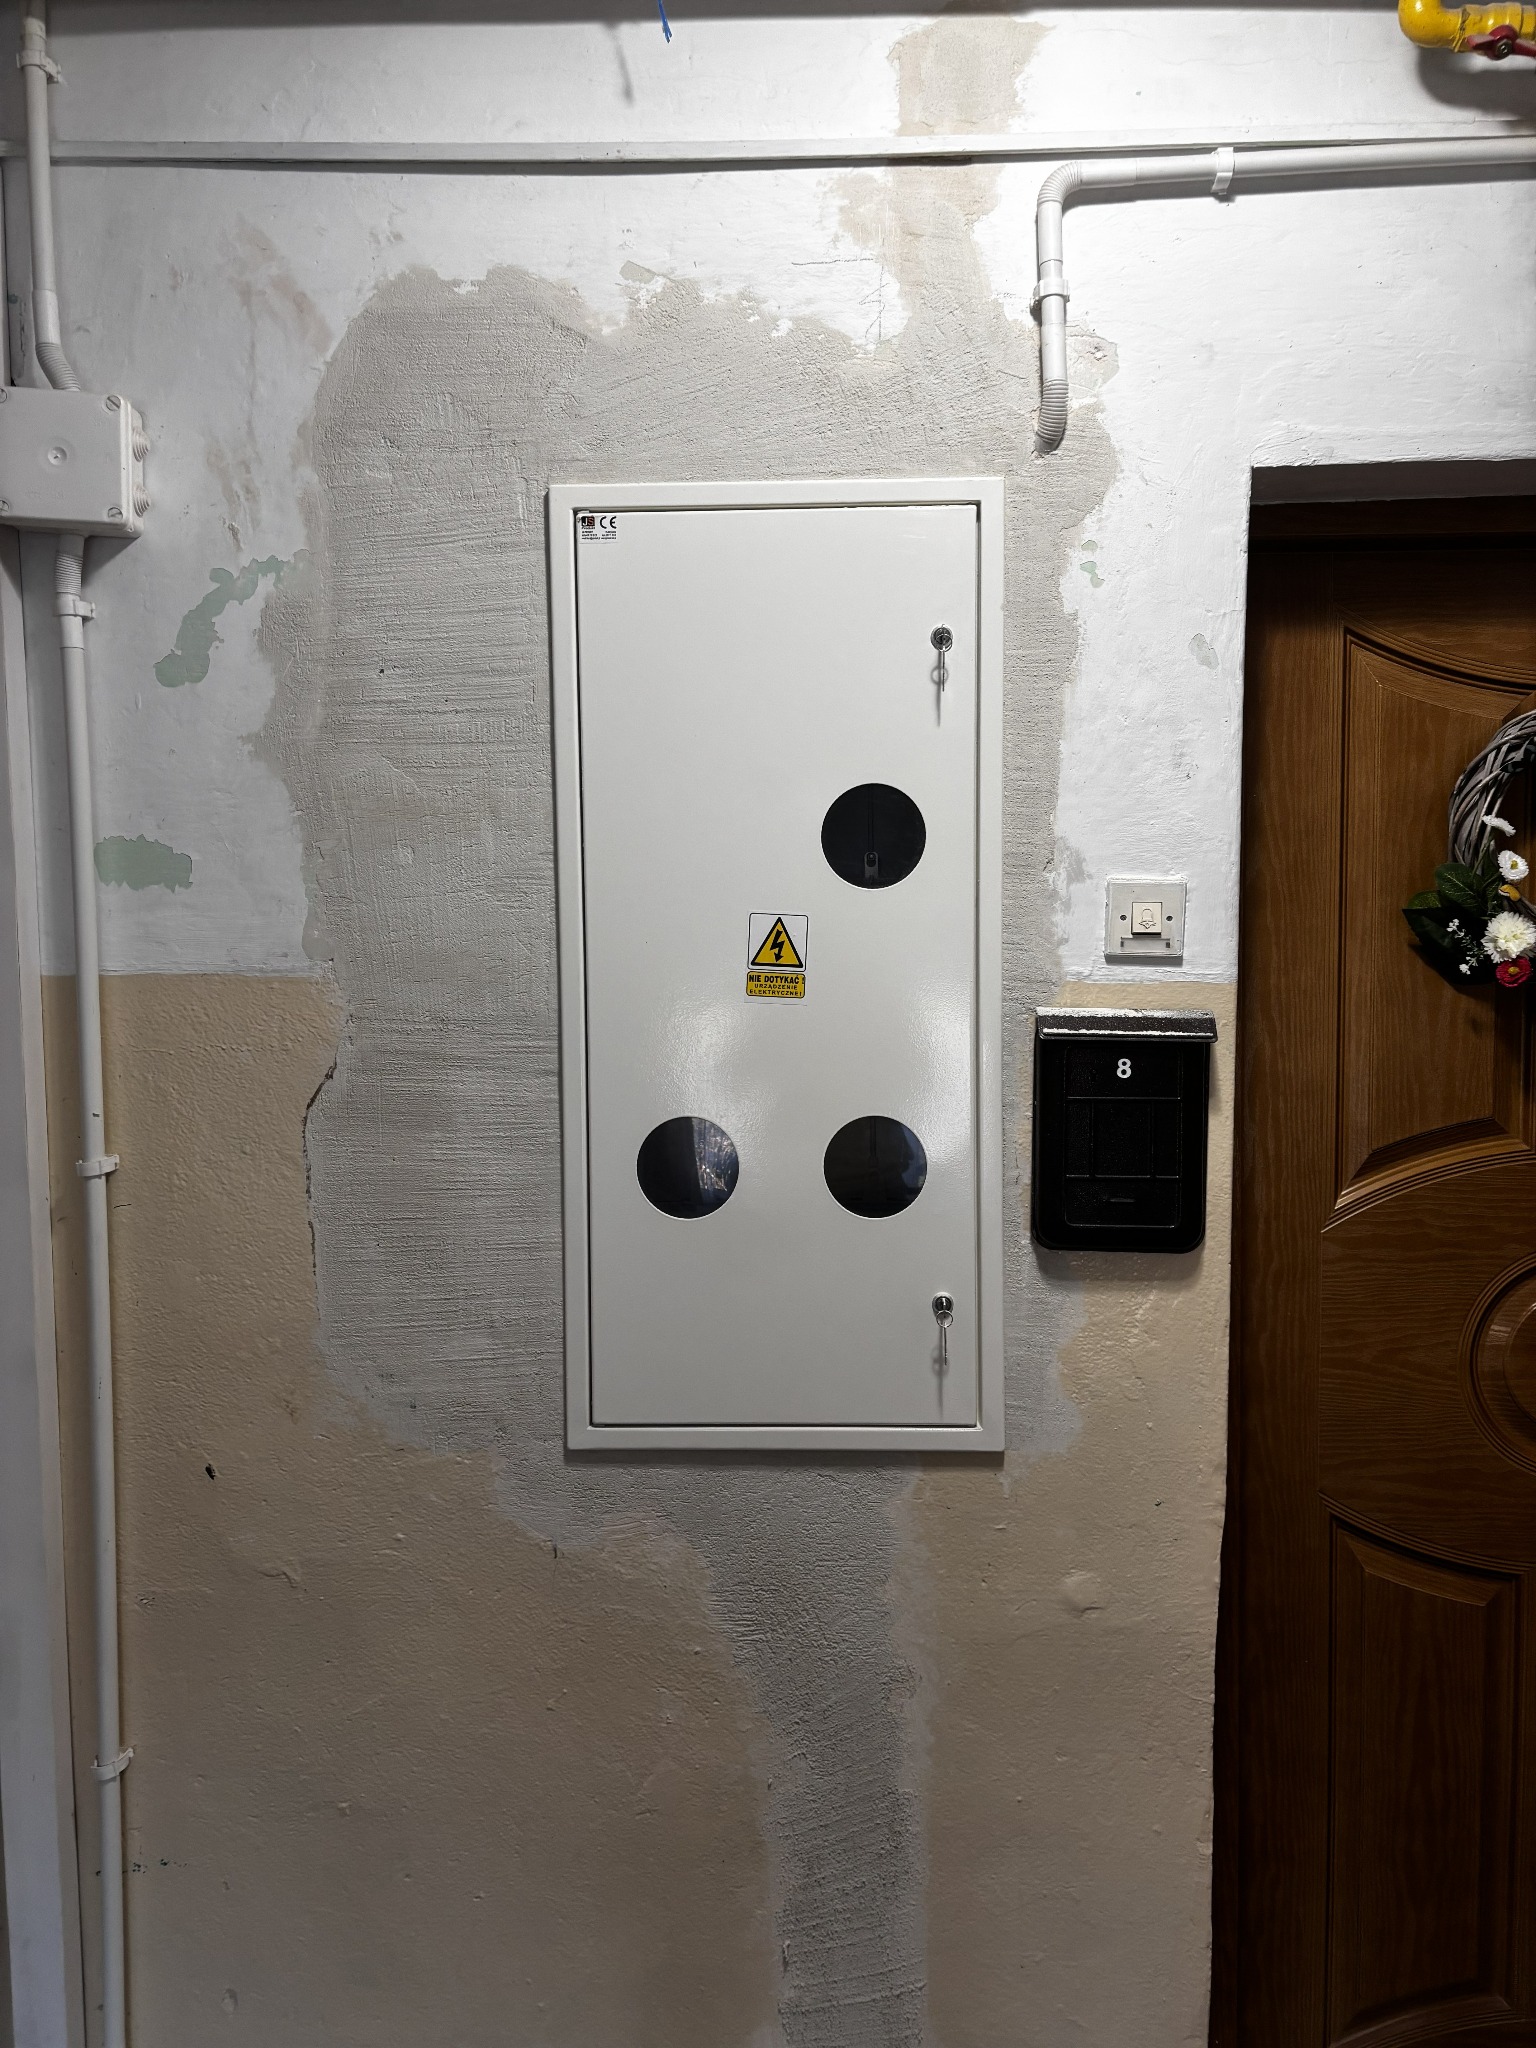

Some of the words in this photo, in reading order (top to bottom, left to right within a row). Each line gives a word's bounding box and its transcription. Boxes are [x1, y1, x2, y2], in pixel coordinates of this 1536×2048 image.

[600, 516, 617, 529] CE
[749, 974, 761, 983] NIE
[764, 975, 799, 985] DOTYKAĆ
[1116, 1058, 1132, 1078] 8
